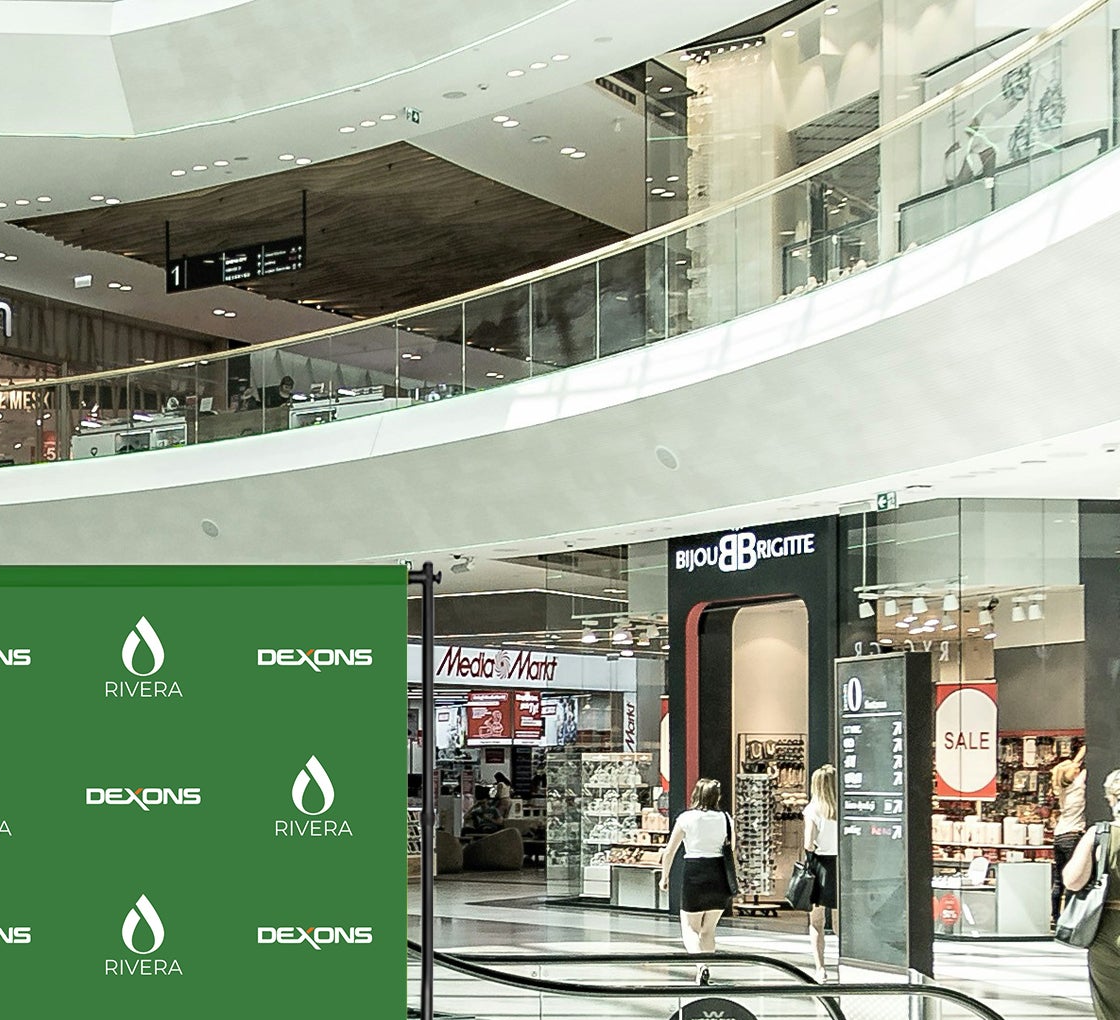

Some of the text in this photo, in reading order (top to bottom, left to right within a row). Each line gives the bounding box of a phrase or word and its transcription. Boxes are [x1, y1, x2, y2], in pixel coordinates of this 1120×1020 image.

[171, 266, 180, 286] 1
[258, 649, 372, 672] DEXONS
[436, 645, 558, 681] Media Markt
[106, 682, 182, 697] RIVERA
[944, 732, 990, 749] SALE
[86, 788, 201, 811] DEXONS
[276, 821, 352, 836] RIVERA
[258, 927, 372, 950] DEXONS
[106, 960, 182, 975] RIVERA
